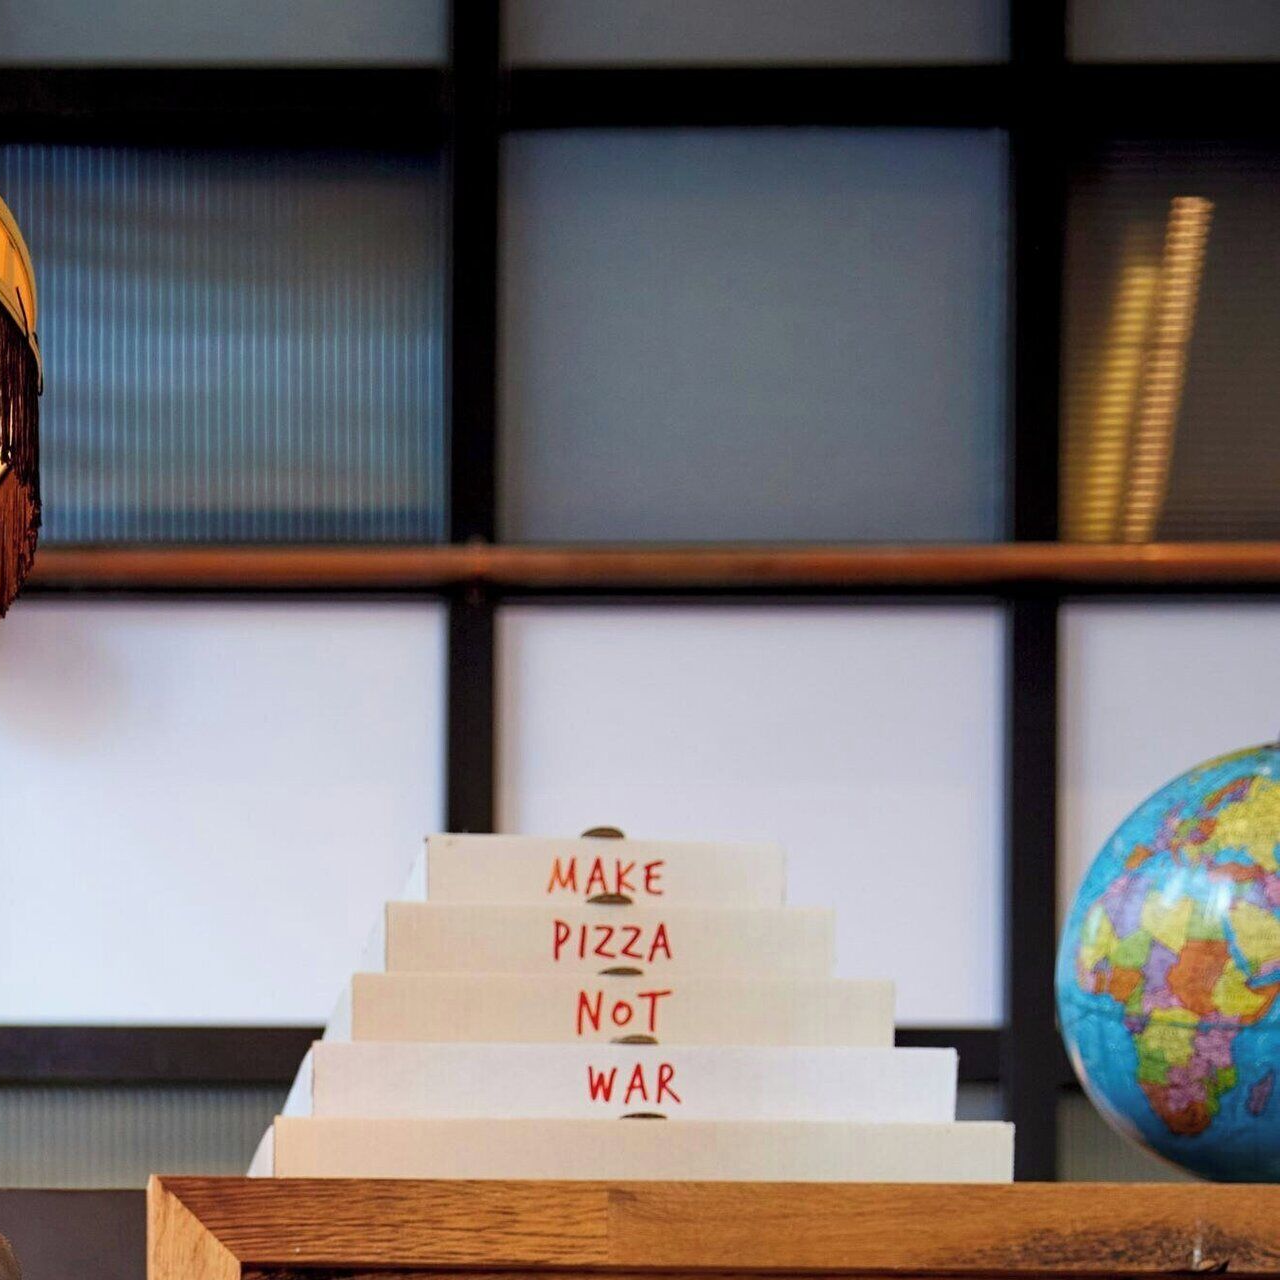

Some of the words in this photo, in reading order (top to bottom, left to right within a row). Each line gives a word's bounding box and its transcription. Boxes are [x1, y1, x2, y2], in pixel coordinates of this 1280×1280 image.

[546, 857, 668, 897] MAKE
[553, 919, 673, 962] PIZZA
[576, 989, 673, 1036] NOT
[587, 1062, 683, 1104] WAR
